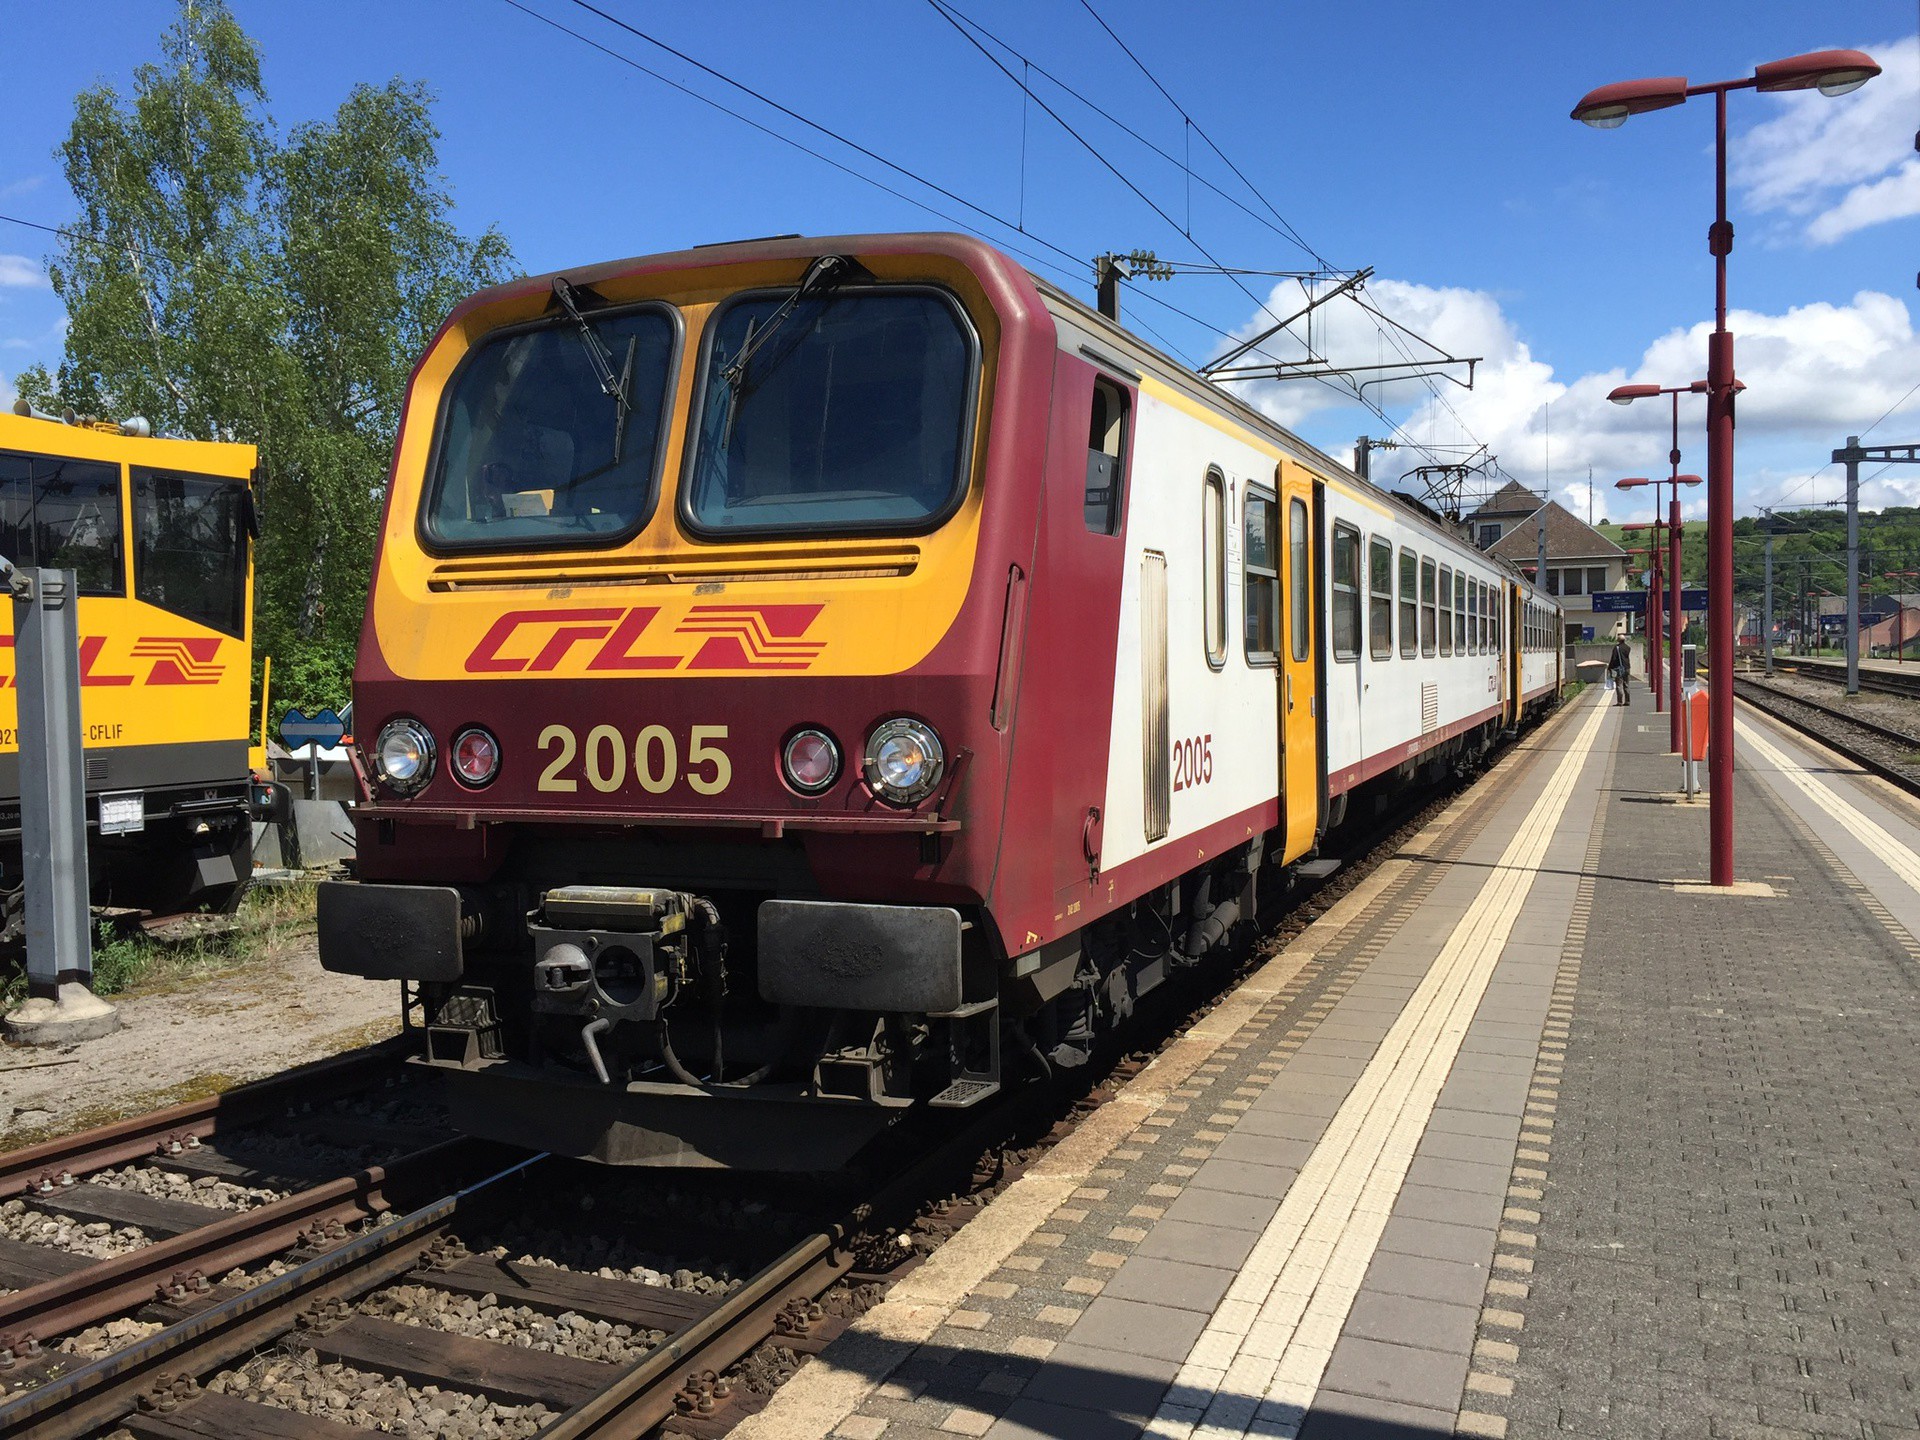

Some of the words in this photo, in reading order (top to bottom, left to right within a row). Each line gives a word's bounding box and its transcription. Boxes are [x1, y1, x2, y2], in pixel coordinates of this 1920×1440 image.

[464, 605, 686, 673] CFL
[537, 724, 733, 796] 2005
[1173, 734, 1212, 792] 2005
